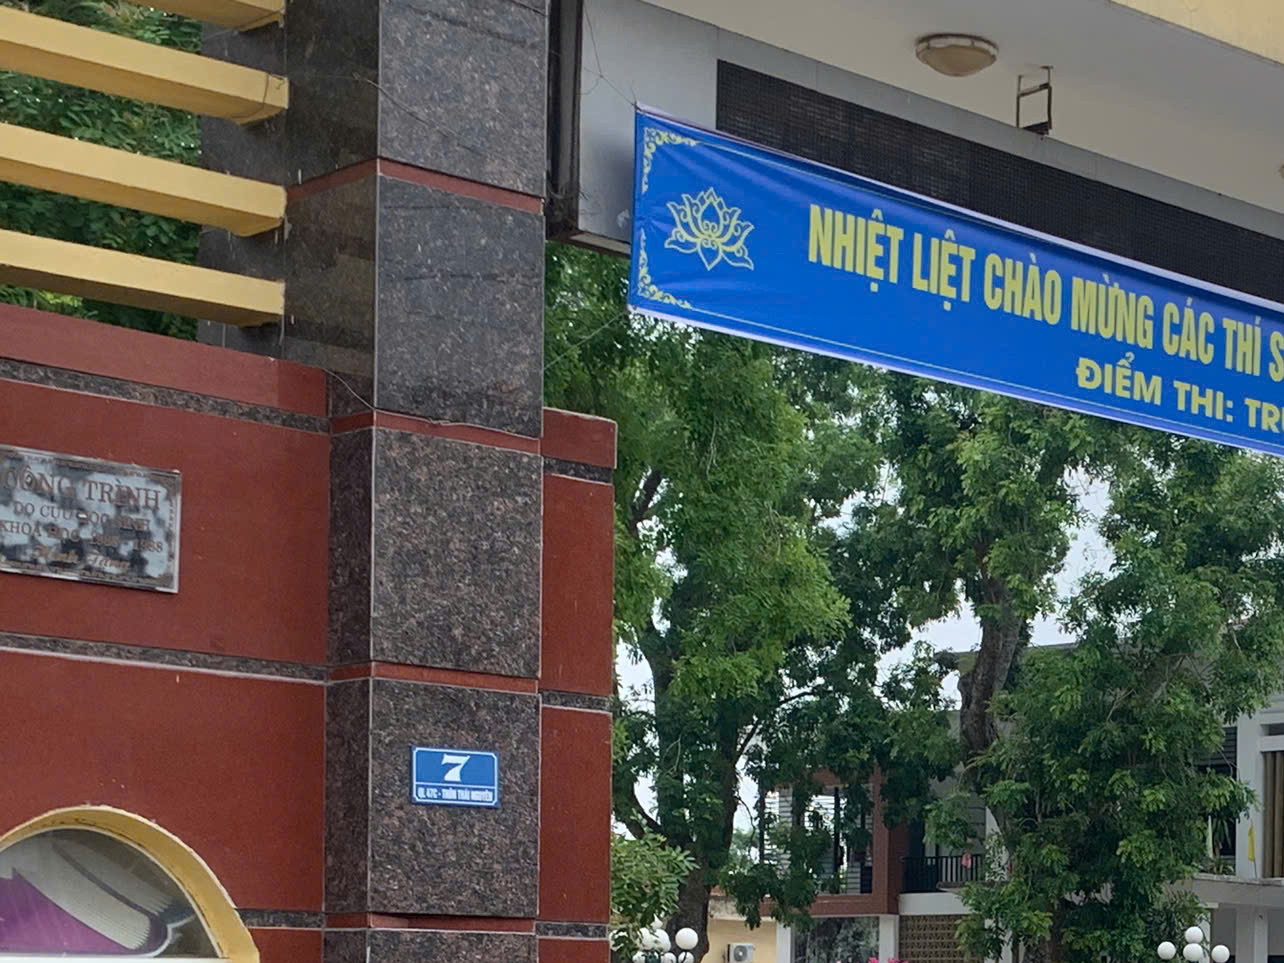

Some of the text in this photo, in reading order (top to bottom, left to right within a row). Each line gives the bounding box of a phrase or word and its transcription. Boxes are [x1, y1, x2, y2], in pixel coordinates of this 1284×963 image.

[808, 204, 904, 293] NHIỆT
[912, 230, 976, 311] LIỆT
[984, 253, 1062, 325] CHÀO
[1071, 272, 1154, 350] MỪNG
[1163, 298, 1215, 366] CÁC
[1223, 315, 1262, 377] THÍ
[1076, 351, 1162, 405] ĐIỂM
[1174, 381, 1233, 423] THI:
[441, 753, 470, 782] 7
